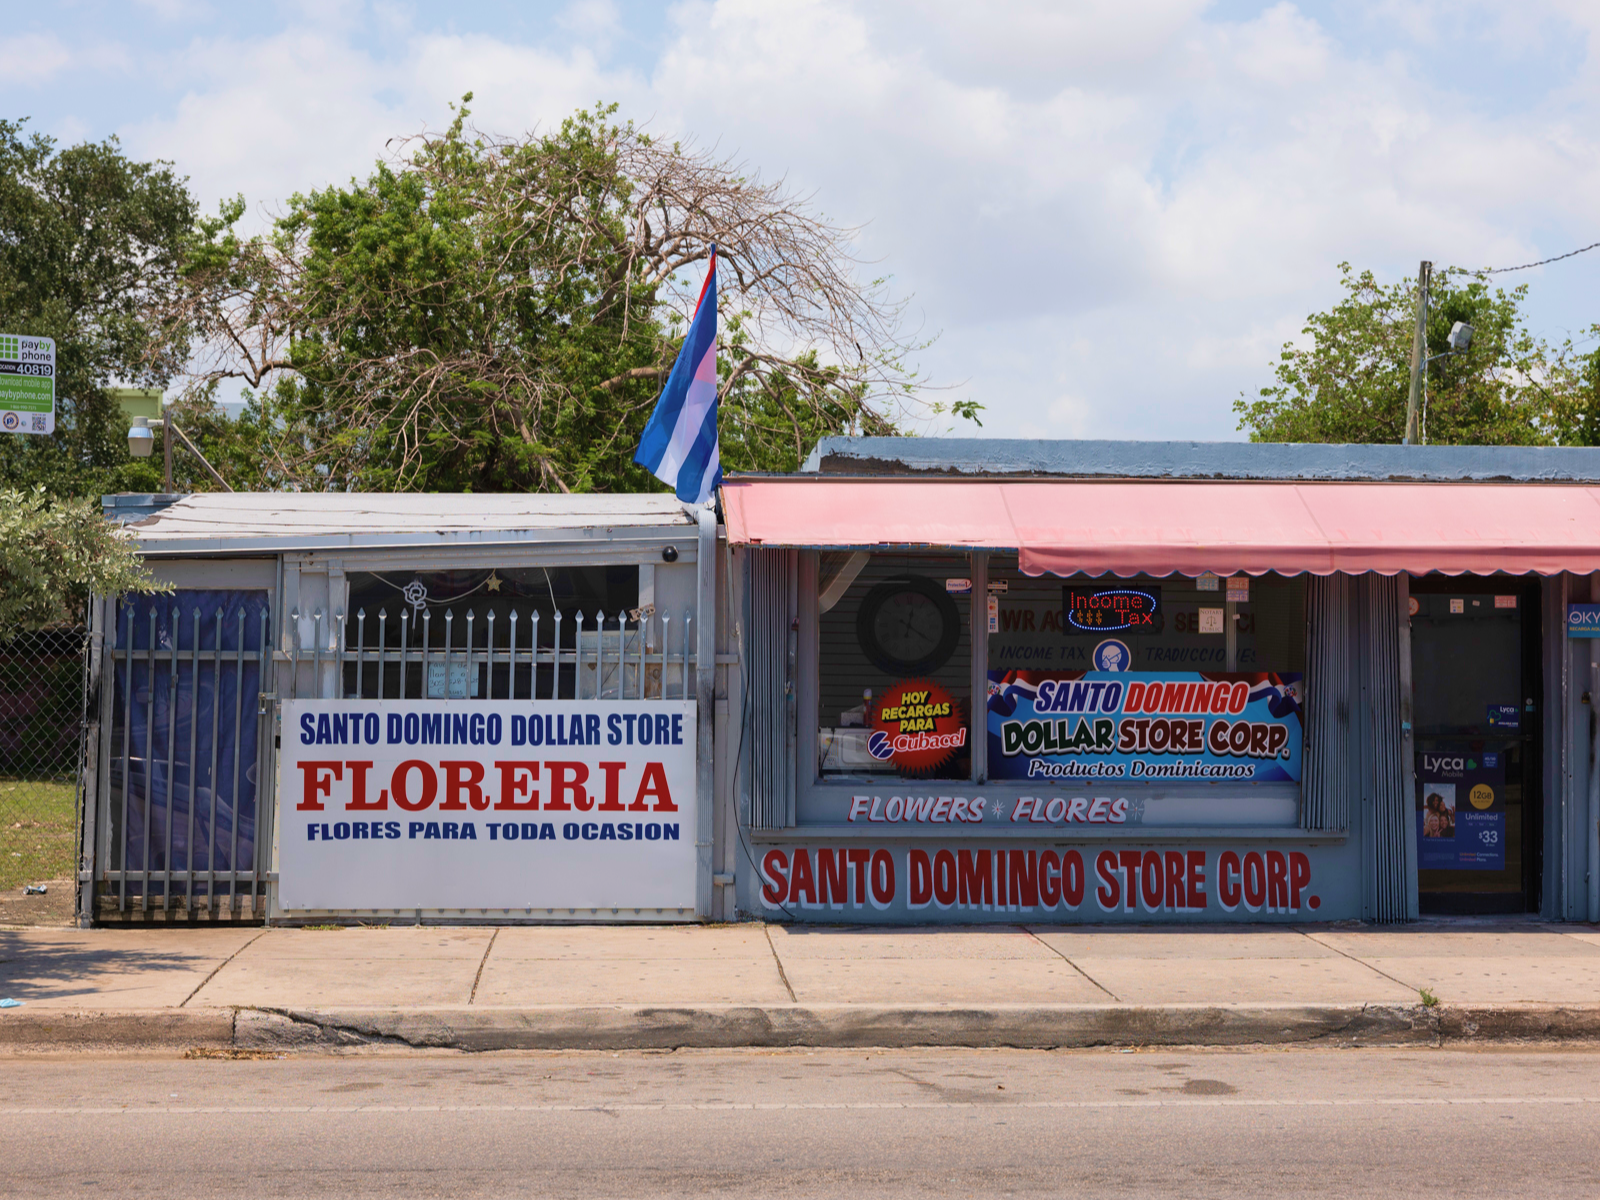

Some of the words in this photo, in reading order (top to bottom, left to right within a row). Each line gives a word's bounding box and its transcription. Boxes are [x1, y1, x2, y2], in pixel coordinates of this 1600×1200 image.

[21, 340, 51, 352] payby
[21, 350, 52, 361] phone
[17, 364, 52, 376] 40819
[23, 378, 40, 388] mobile
[41, 381, 51, 390] app
[1071, 592, 1142, 609] Income
[1115, 609, 1152, 624] Tax
[999, 645, 1053, 660] INCOME
[1060, 646, 1086, 660] TAX
[901, 691, 929, 706] HOY
[1034, 680, 1122, 714] SANTO
[1122, 681, 1249, 714] DOMINGO
[881, 703, 950, 720] RECARGAS
[300, 712, 380, 745] SANTO
[387, 712, 502, 746] DOMINGO
[511, 714, 601, 746] DOLLAR
[607, 713, 684, 745] STORE
[899, 718, 934, 733] PARA
[893, 727, 966, 752] Cubacel
[1002, 717, 1114, 755] DOLLAR
[1118, 717, 1204, 754] STORE
[1208, 718, 1290, 758] CORP.
[1028, 759, 1125, 777] Productos
[1130, 760, 1255, 778] Dominicanos
[1424, 754, 1464, 773] Lyca
[296, 759, 679, 812] FLORERIA
[1473, 790, 1492, 799] 12GB
[847, 796, 987, 823] FLOWERS
[1009, 797, 1129, 823] FLORES
[1465, 813, 1498, 821] Unlimited
[307, 821, 402, 841] FLORES
[408, 822, 478, 840] PARA
[485, 823, 557, 841] TODA
[562, 822, 680, 841] OCASION
[1478, 830, 1498, 843] $33
[761, 848, 895, 910] SANTO
[908, 849, 1085, 911] DOMINGO
[1096, 850, 1207, 913] STORE
[1218, 850, 1321, 913] CORP.
